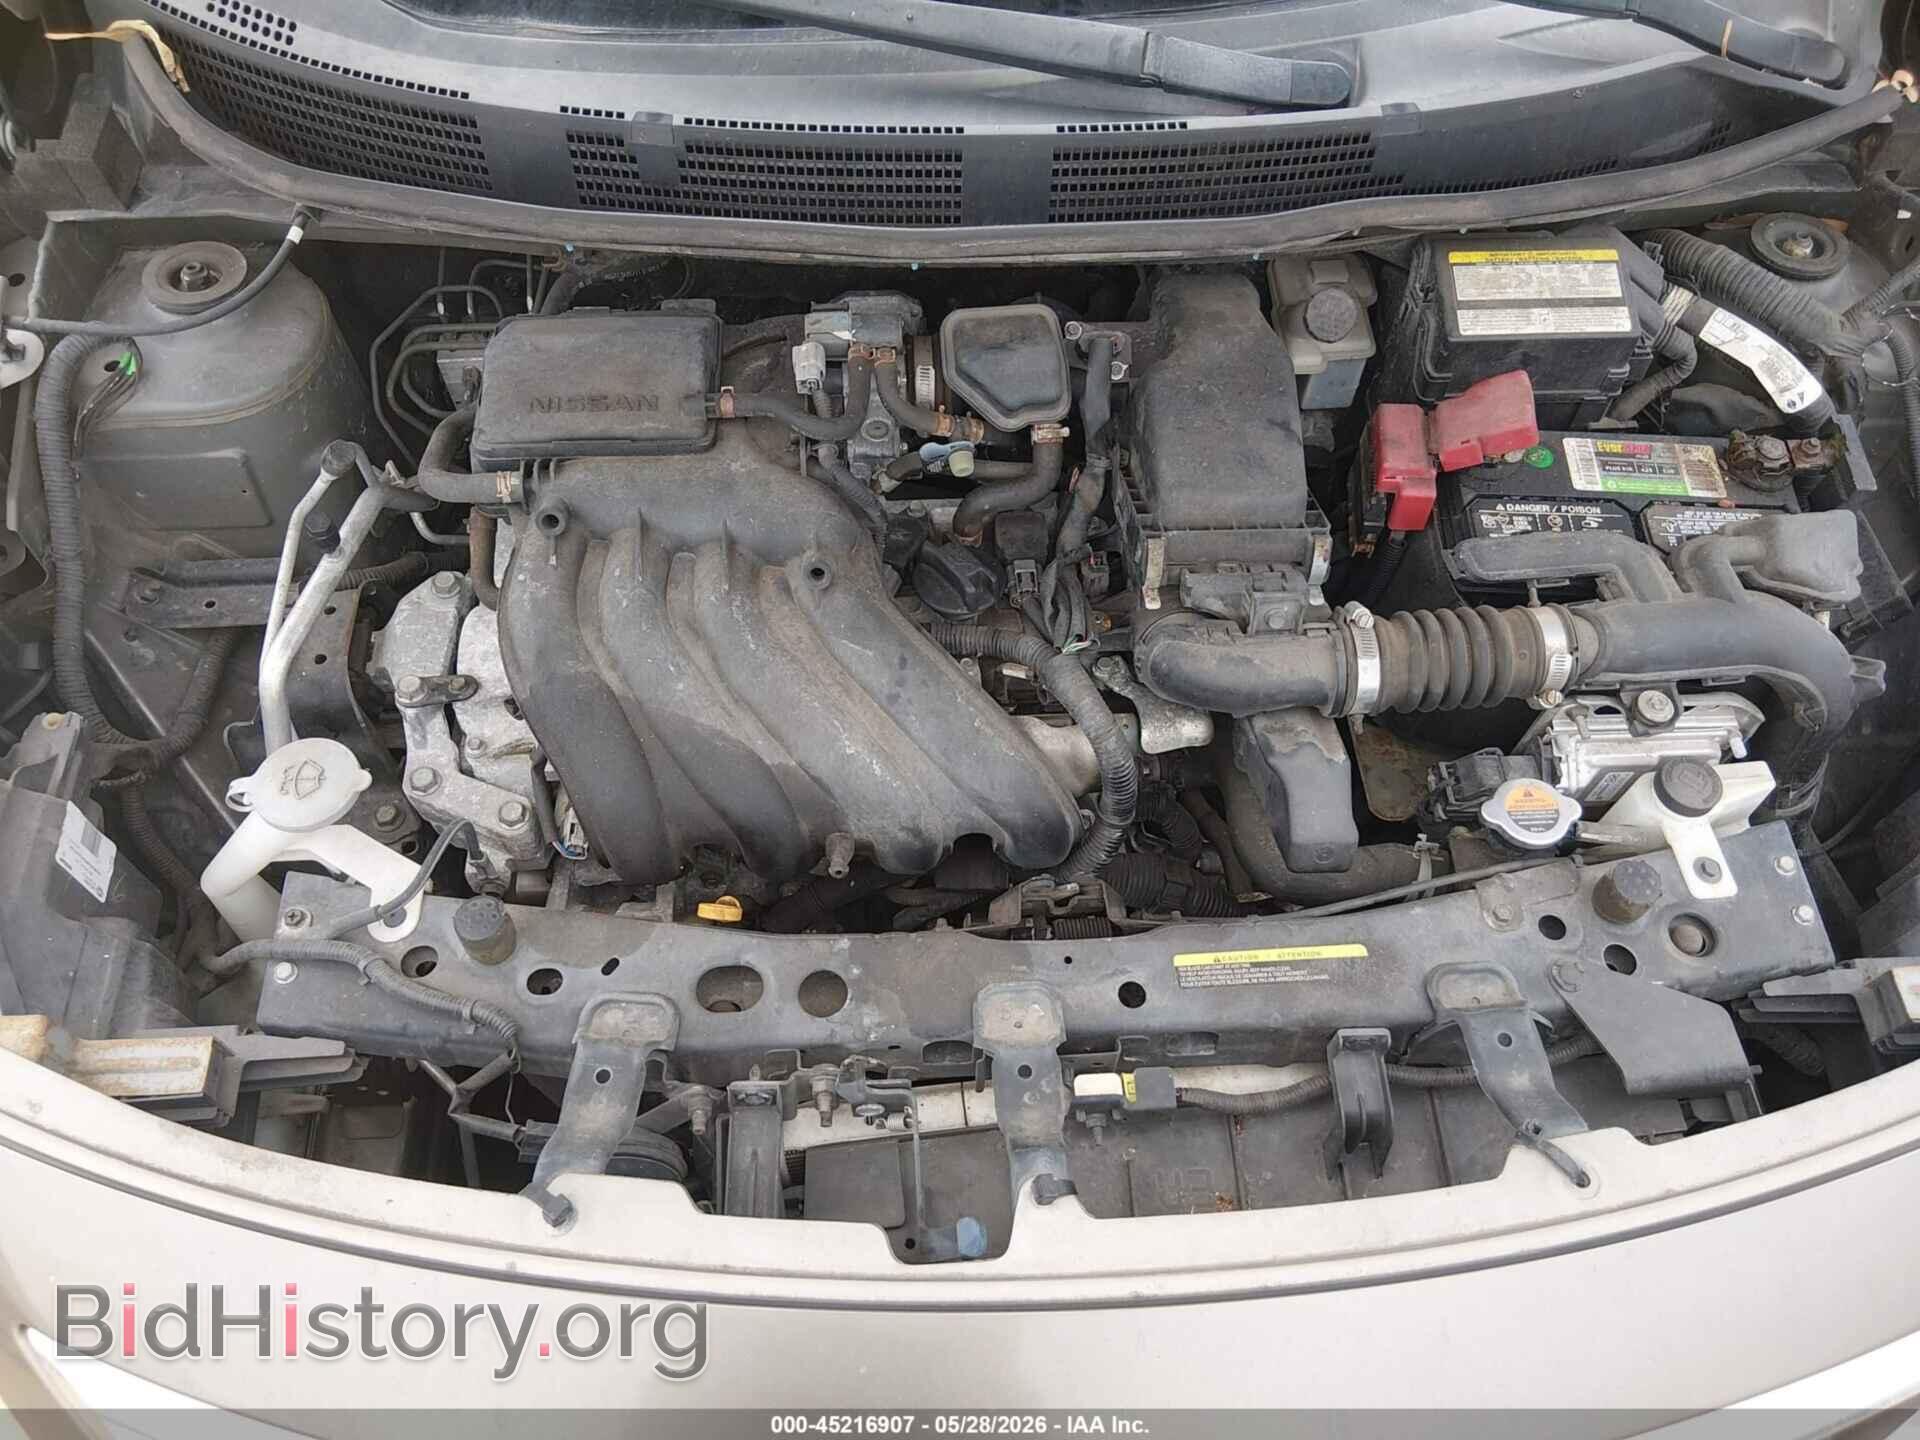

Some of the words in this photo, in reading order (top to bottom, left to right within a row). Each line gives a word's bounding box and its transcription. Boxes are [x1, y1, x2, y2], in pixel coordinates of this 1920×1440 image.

[529, 393, 660, 414] NISSAN
[1506, 503, 1550, 513] DANGER
[1561, 504, 1601, 514] POISON
[1222, 954, 1259, 962] CAUTION
[1277, 950, 1322, 959] ATTENTION
